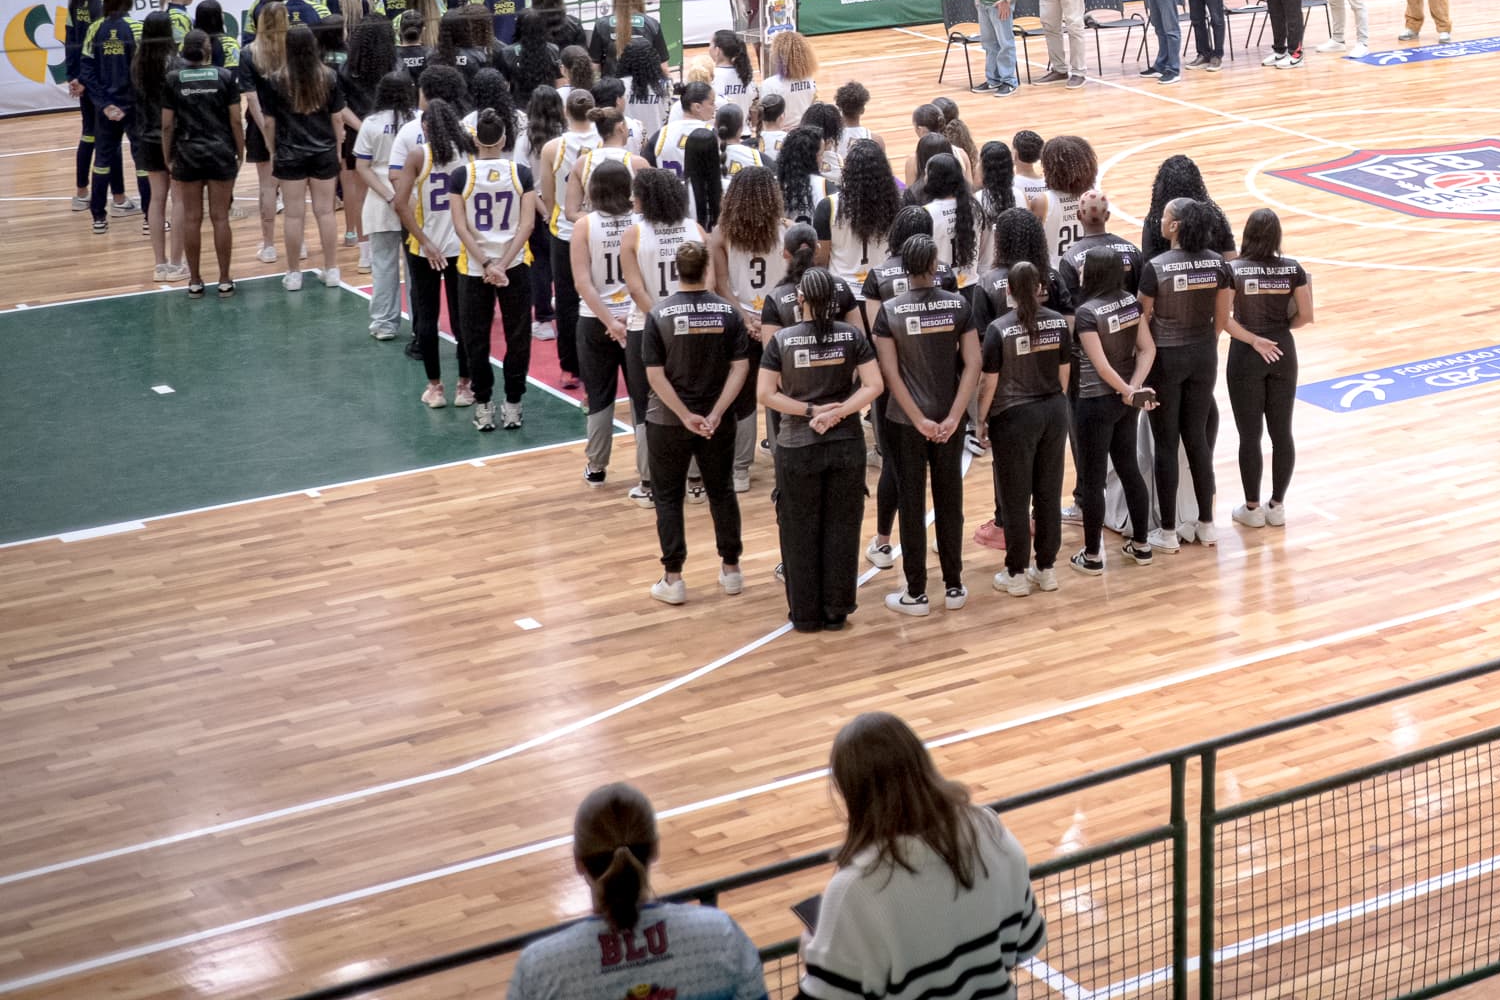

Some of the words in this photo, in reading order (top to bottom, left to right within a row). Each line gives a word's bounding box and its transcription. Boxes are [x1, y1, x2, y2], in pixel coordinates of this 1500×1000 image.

[790, 82, 811, 92] ATLETA
[1358, 152, 1485, 180] BFB
[474, 190, 513, 232] 87
[602, 239, 621, 249] TAVA
[660, 248, 678, 257] GIUL
[1162, 260, 1194, 272] MESQUITA
[1194, 259, 1222, 269] BASQUETE
[1235, 266, 1266, 276] MESQUITA
[1266, 265, 1298, 275] BASQUETE
[749, 256, 767, 290] 3
[1188, 276, 1217, 284] MESQUITA
[659, 303, 696, 318] MESQUITA
[696, 302, 733, 314] BASQUETE
[894, 302, 927, 315] MESQUITA
[928, 300, 962, 311] BASQUETE
[1094, 302, 1121, 315] MESQUITA
[689, 319, 723, 328] MESQUITA
[920, 317, 954, 328] MESQUITA
[1037, 319, 1068, 330] BASQUETE
[784, 334, 818, 346] MESQUITA
[1393, 350, 1494, 376] FORMAÇÃO
[1425, 366, 1500, 387] CBC
[598, 919, 670, 967] BLU
